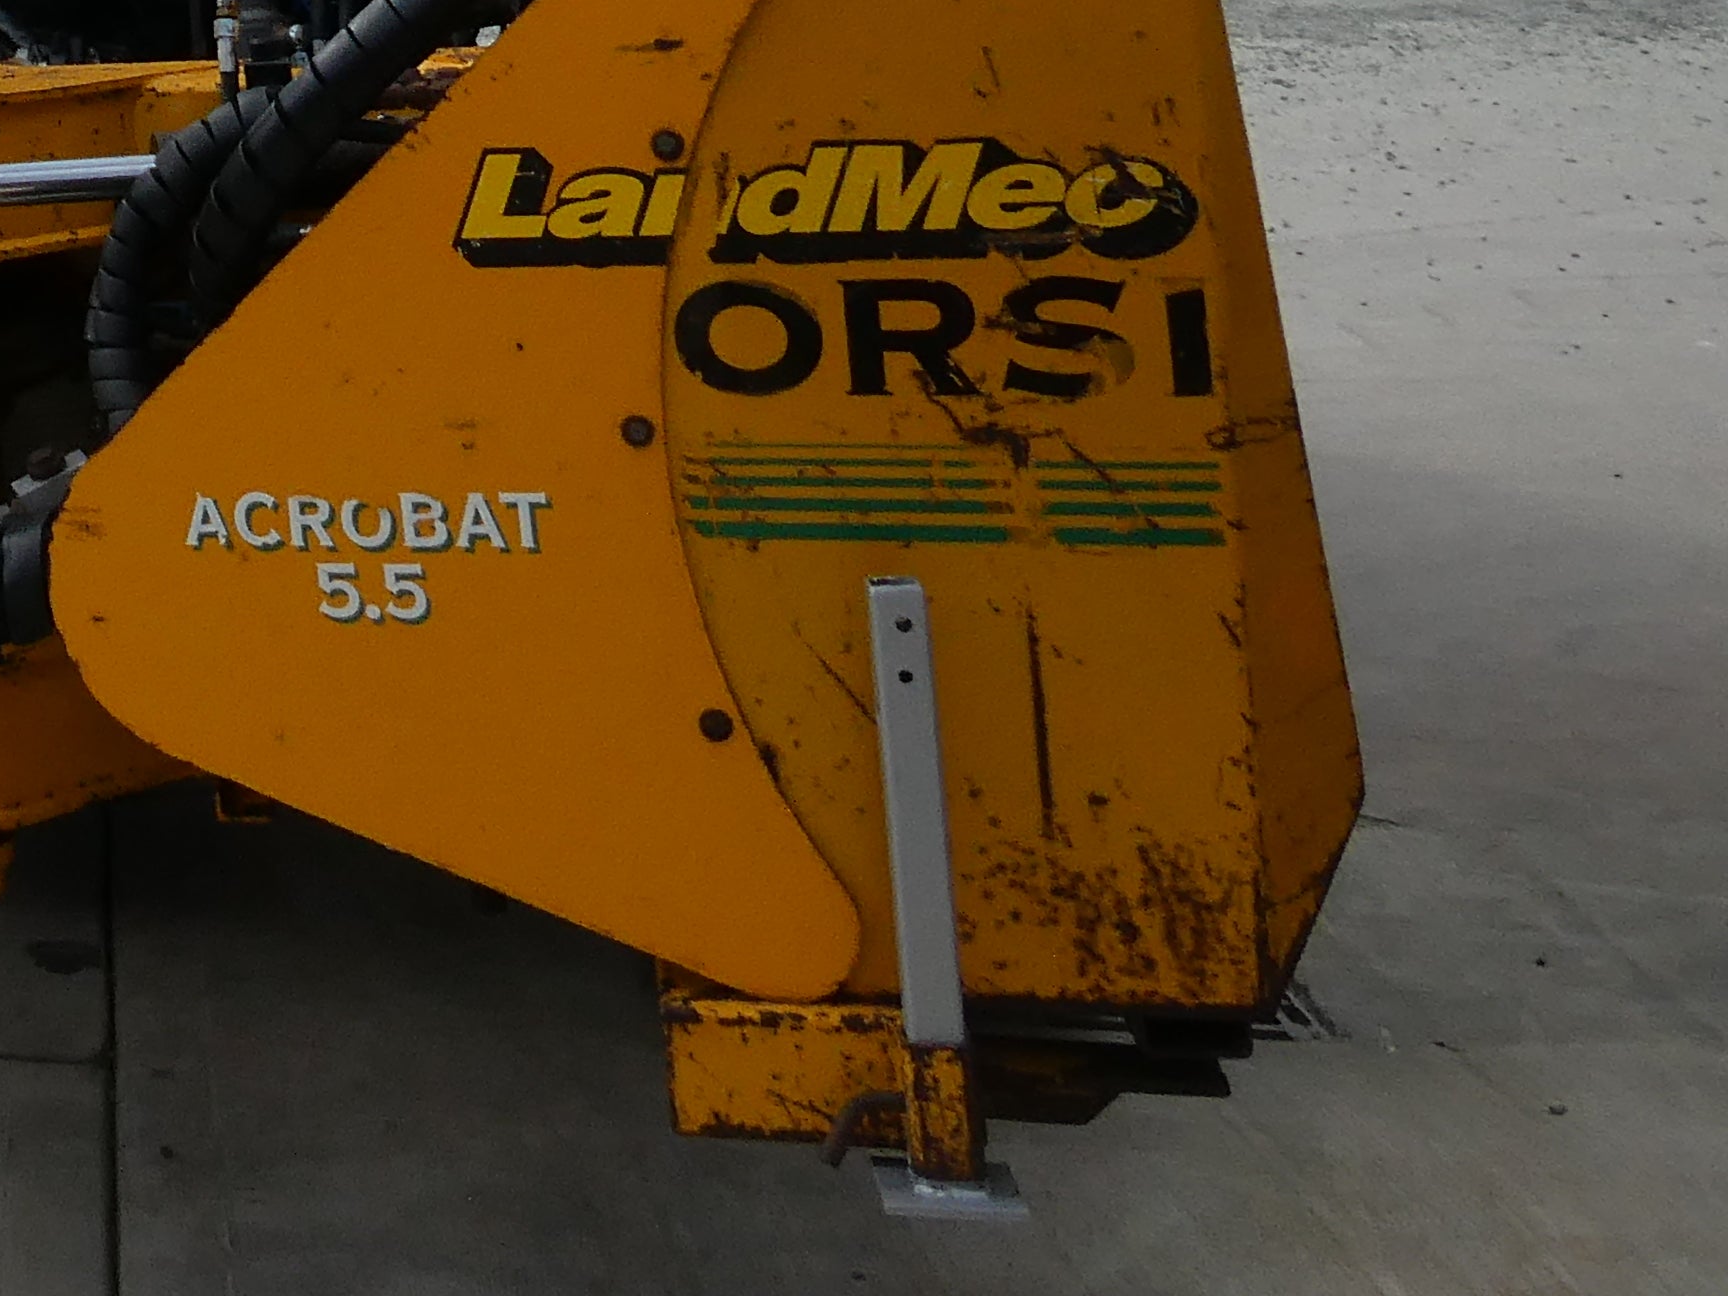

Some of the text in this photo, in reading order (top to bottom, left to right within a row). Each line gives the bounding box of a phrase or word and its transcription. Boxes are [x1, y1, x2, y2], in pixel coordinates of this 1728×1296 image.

[674, 276, 1213, 397] ORSI
[185, 491, 553, 553] ACROBAT
[315, 562, 431, 624] 5.5
